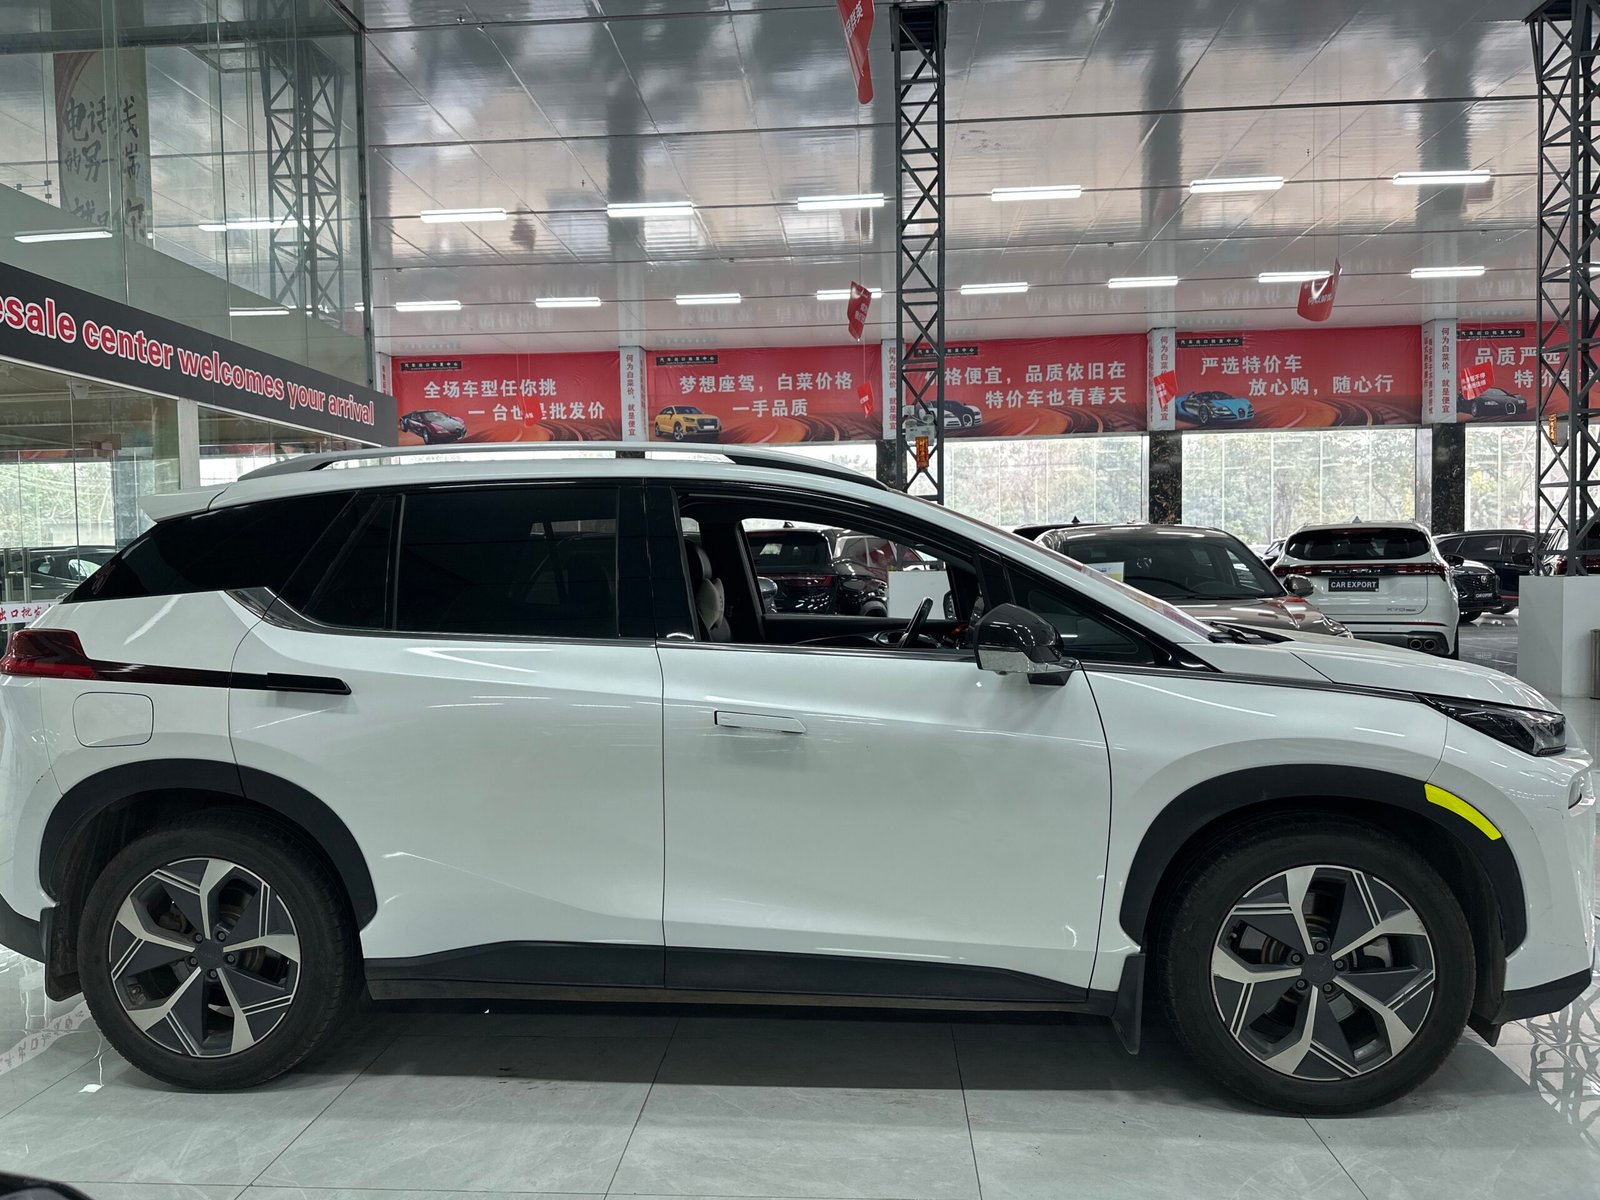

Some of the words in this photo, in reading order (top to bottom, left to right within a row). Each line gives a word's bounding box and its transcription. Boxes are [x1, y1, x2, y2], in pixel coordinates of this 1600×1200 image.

[82, 320, 173, 369] center
[177, 350, 285, 401] welcomes
[287, 379, 326, 410] your
[328, 394, 375, 426] arrival
[1201, 354, 1303, 376] 严选特价车
[423, 378, 557, 399] 全场车型任你挑
[679, 371, 853, 394] 梦想座驾，白菜价格
[1249, 374, 1394, 396] 放心购，随心行
[732, 398, 808, 418] 一手品质
[985, 386, 1128, 409] 特价车也有春天
[1330, 581, 1346, 589] CAR
[1347, 581, 1377, 589] EXPORT
